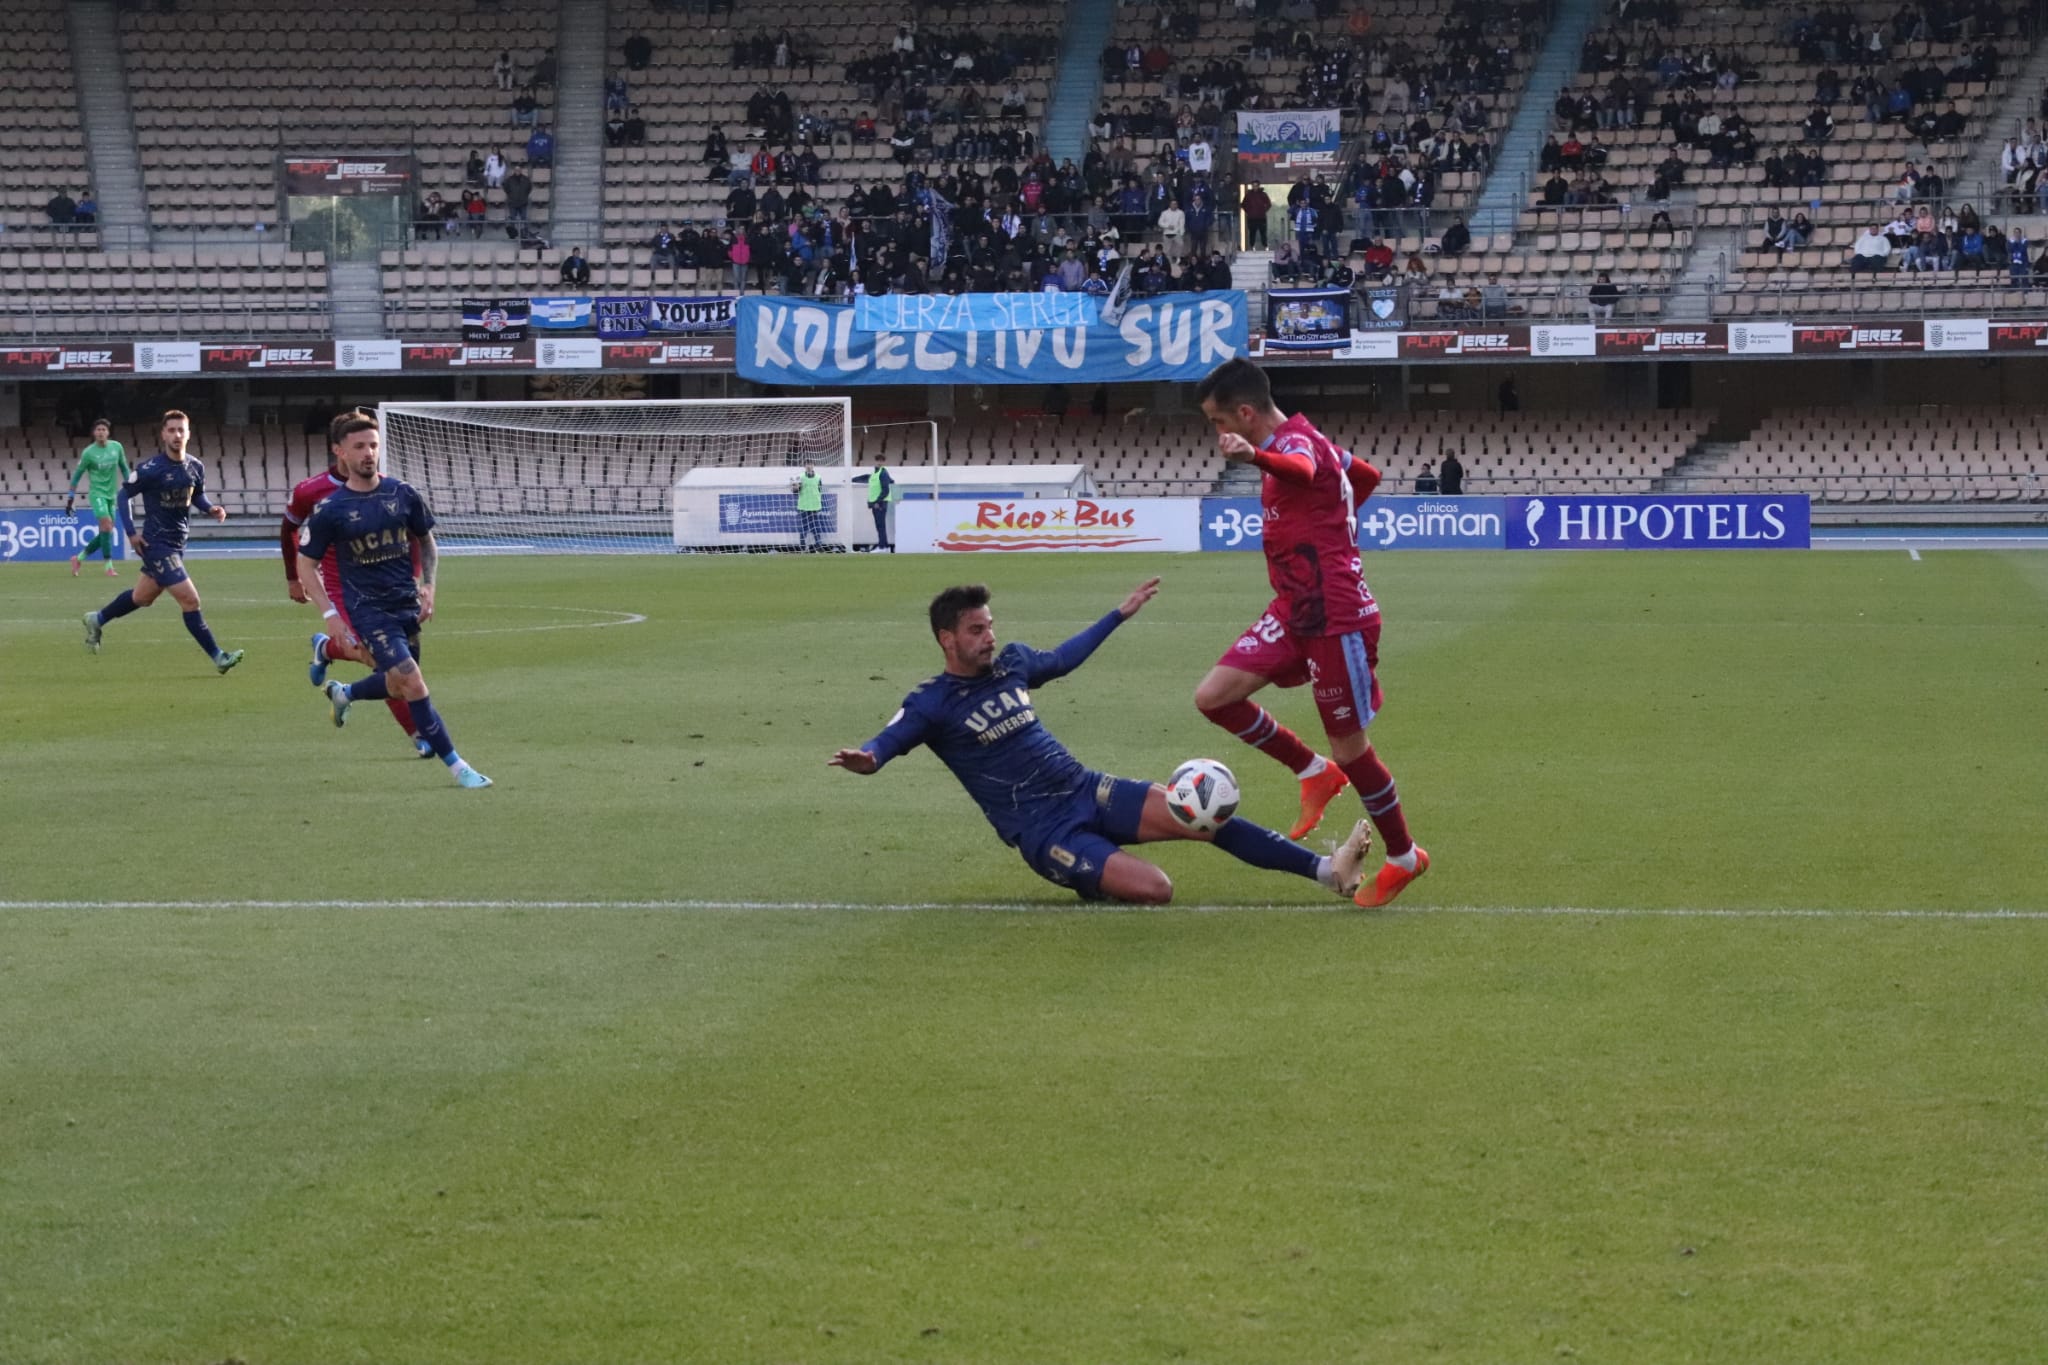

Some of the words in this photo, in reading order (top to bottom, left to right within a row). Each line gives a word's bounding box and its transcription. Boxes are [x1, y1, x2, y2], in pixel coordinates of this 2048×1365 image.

[287, 163, 332, 175] PLAY
[325, 163, 387, 180] JEREZ
[599, 300, 647, 317] NEW
[656, 300, 732, 324] YOUTH
[864, 293, 975, 330] FUERZA
[990, 291, 1090, 330] SERGI
[600, 316, 648, 333] ONES
[1119, 300, 1237, 367] SUR
[1997, 327, 2042, 339] PLAY
[1406, 335, 1454, 347] PLAY
[1445, 334, 1509, 354] JEREZ
[1604, 333, 1651, 345] PLAY
[1642, 332, 1707, 351] JEREZ
[1801, 330, 1849, 342] PLAY
[1840, 329, 1904, 349] JEREZ
[8, 352, 55, 364] PLAY
[47, 351, 112, 370] JEREZ
[209, 349, 256, 361] PLAY
[248, 348, 314, 367] JEREZ
[410, 348, 457, 359] PLAY
[449, 346, 514, 365] JEREZ
[609, 346, 657, 358] PLAY
[649, 345, 714, 364] JEREZ
[1074, 499, 1135, 528] Bus
[1558, 503, 1786, 541] HIPOTELS
